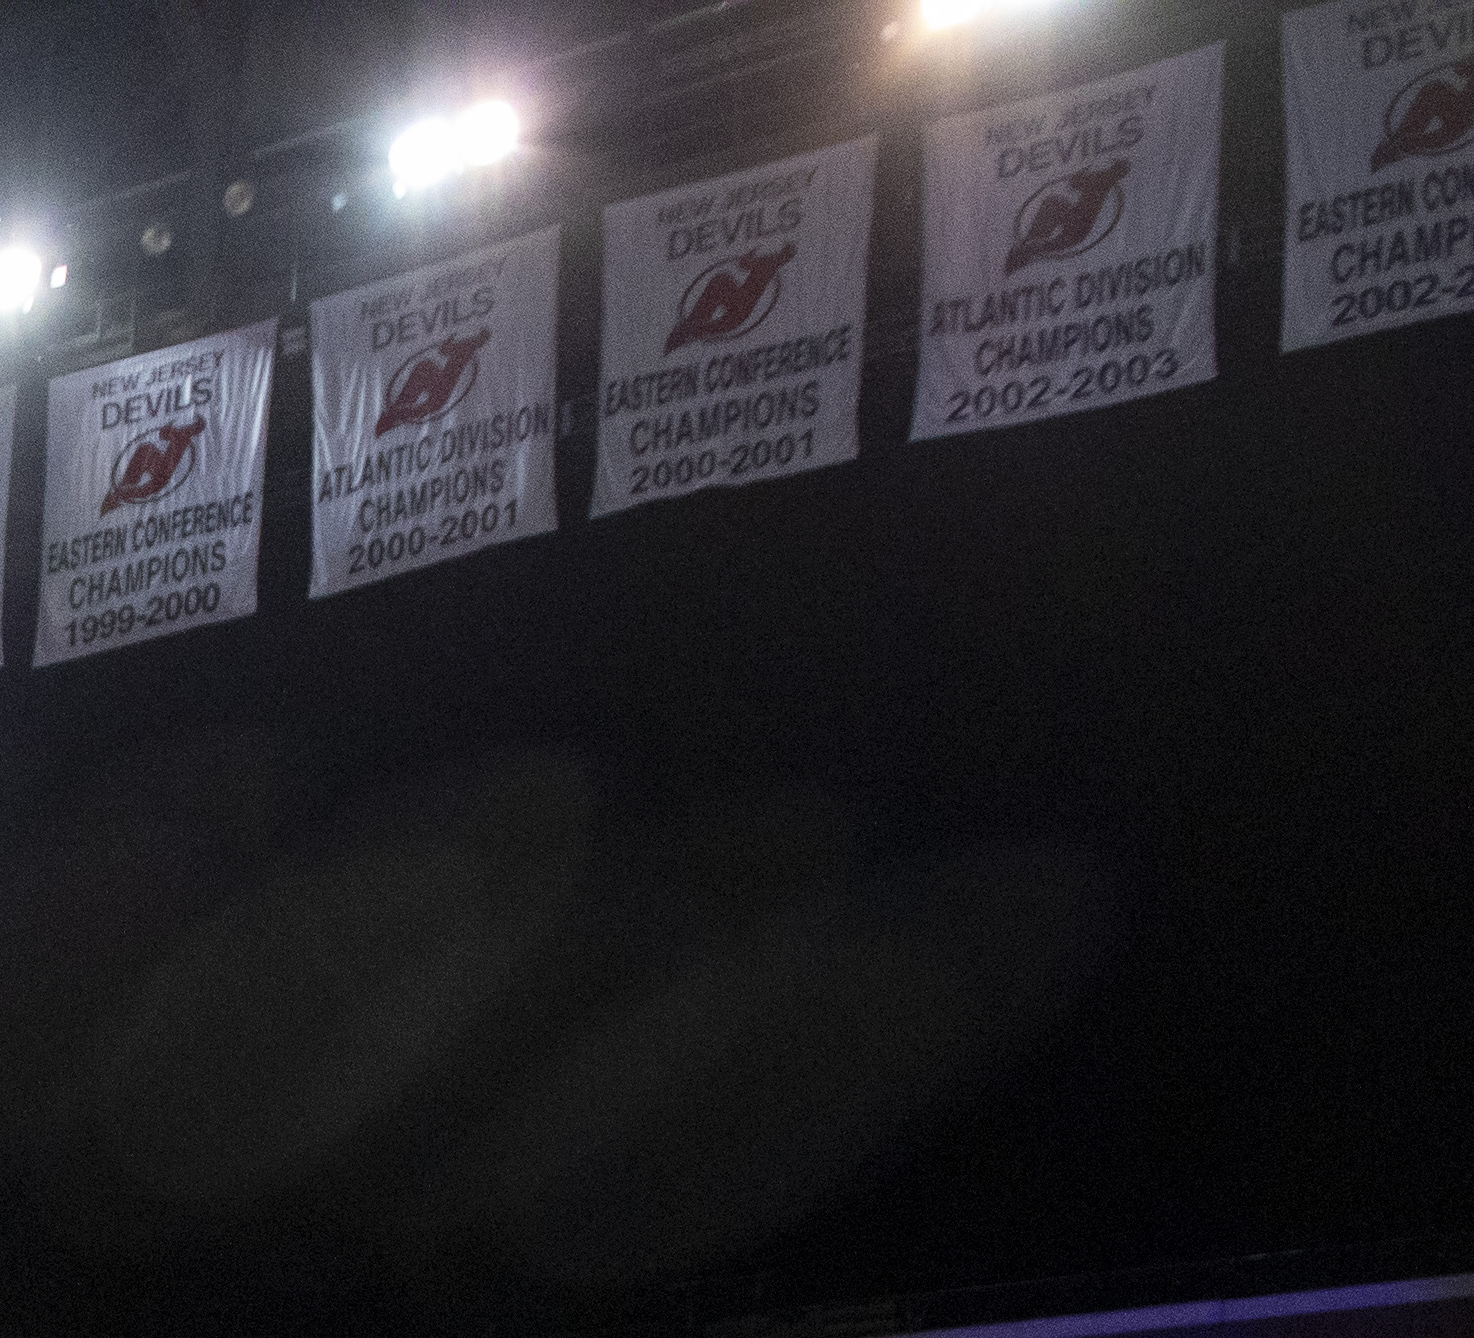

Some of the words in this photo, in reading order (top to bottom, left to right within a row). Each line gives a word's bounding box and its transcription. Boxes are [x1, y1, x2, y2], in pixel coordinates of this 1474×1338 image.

[998, 116, 1144, 179] DEVILS
[667, 198, 803, 261] DEVILS
[371, 289, 495, 350] DEVILS
[931, 279, 1066, 336] ATLANTIC
[1077, 242, 1206, 308] DIVISION
[92, 373, 142, 399] NEW
[146, 351, 224, 384] JERSEY
[603, 361, 701, 418] EASTERN
[706, 325, 852, 392] CONFERENCE
[973, 305, 1155, 376] CHAMPIONS
[101, 378, 212, 430] DEVILS
[629, 380, 821, 456] CHAMPIONS
[944, 351, 1181, 424] 2002-2003
[319, 438, 434, 504] ATLANTIC
[437, 405, 550, 465] DIVISION
[631, 428, 816, 496] 2000-2001
[359, 461, 506, 533] CHAMPIONS
[48, 529, 127, 576] EASTERN
[132, 491, 254, 554] CONFERENCE
[348, 500, 520, 575] 2000-2001
[68, 543, 227, 610] CHAMPIONS
[64, 583, 221, 648] 1999-2000
